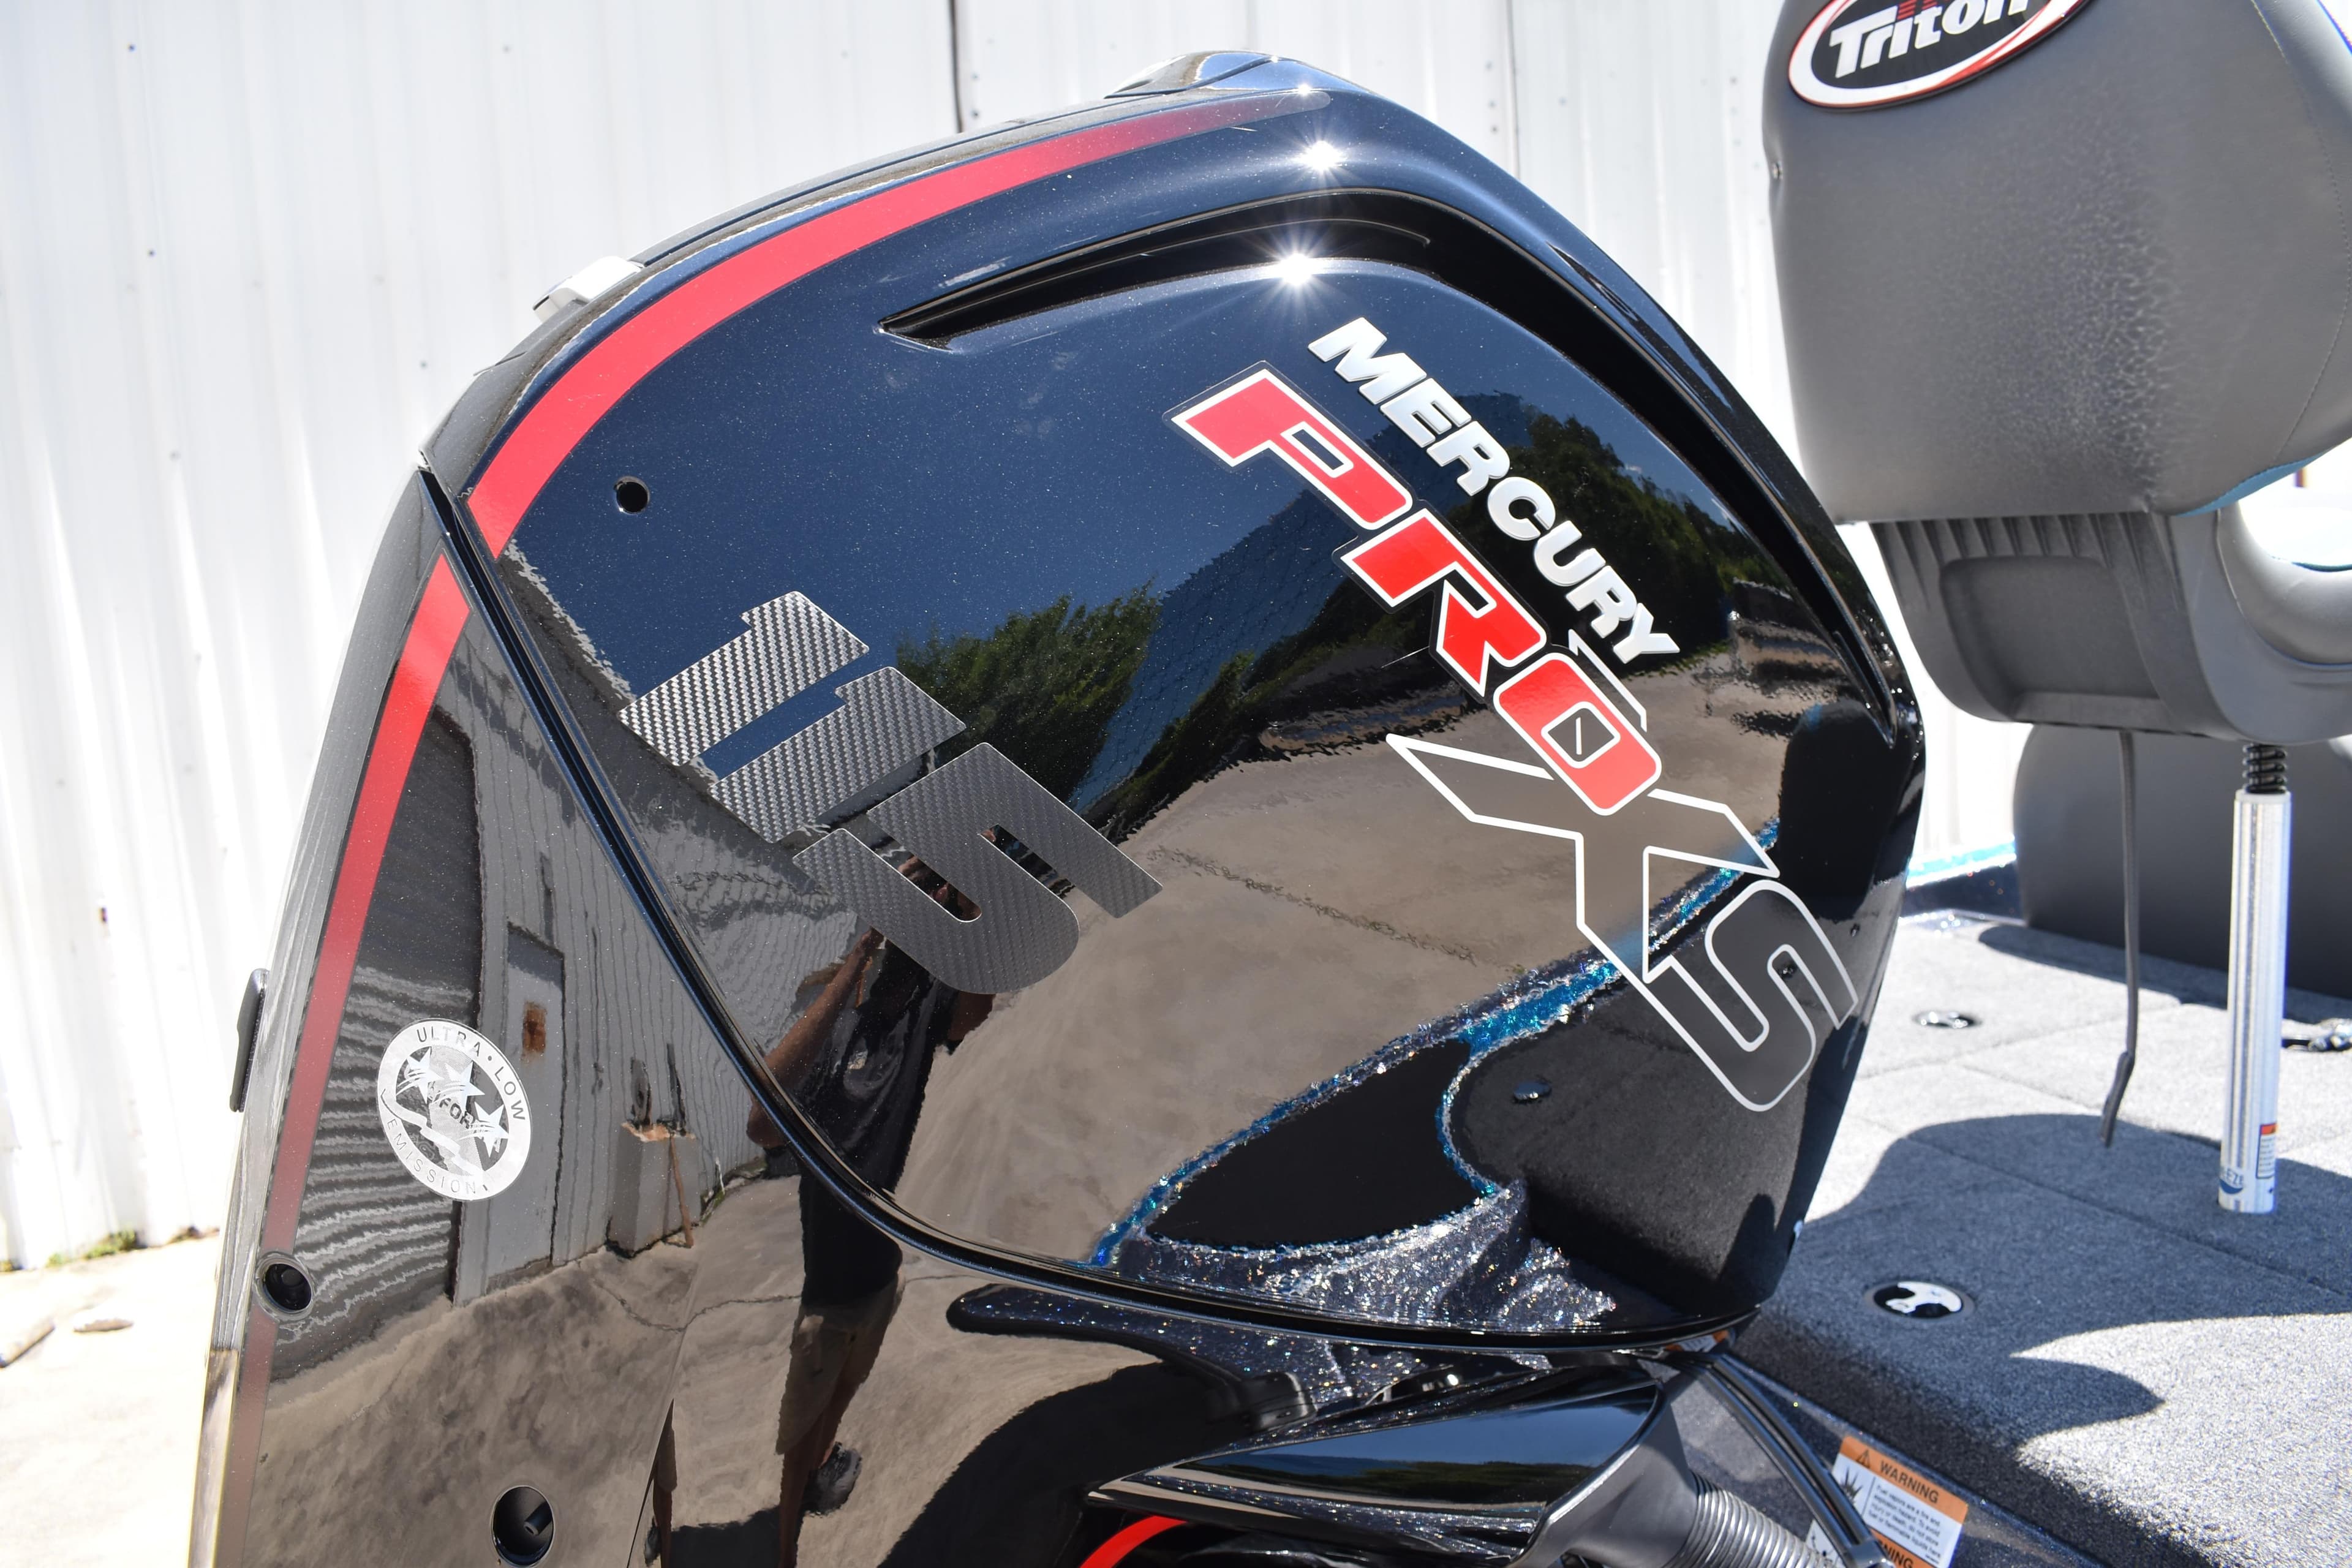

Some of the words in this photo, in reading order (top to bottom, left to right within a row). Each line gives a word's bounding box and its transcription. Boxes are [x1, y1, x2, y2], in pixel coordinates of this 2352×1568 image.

[1308, 317, 1680, 664] MERCURY
[617, 590, 1163, 995] 115
[416, 1026, 481, 1057] ULTRA
[494, 1066, 526, 1120] LOW
[387, 1118, 476, 1194] EMISSION
[1880, 1459, 1939, 1504] WARNING
